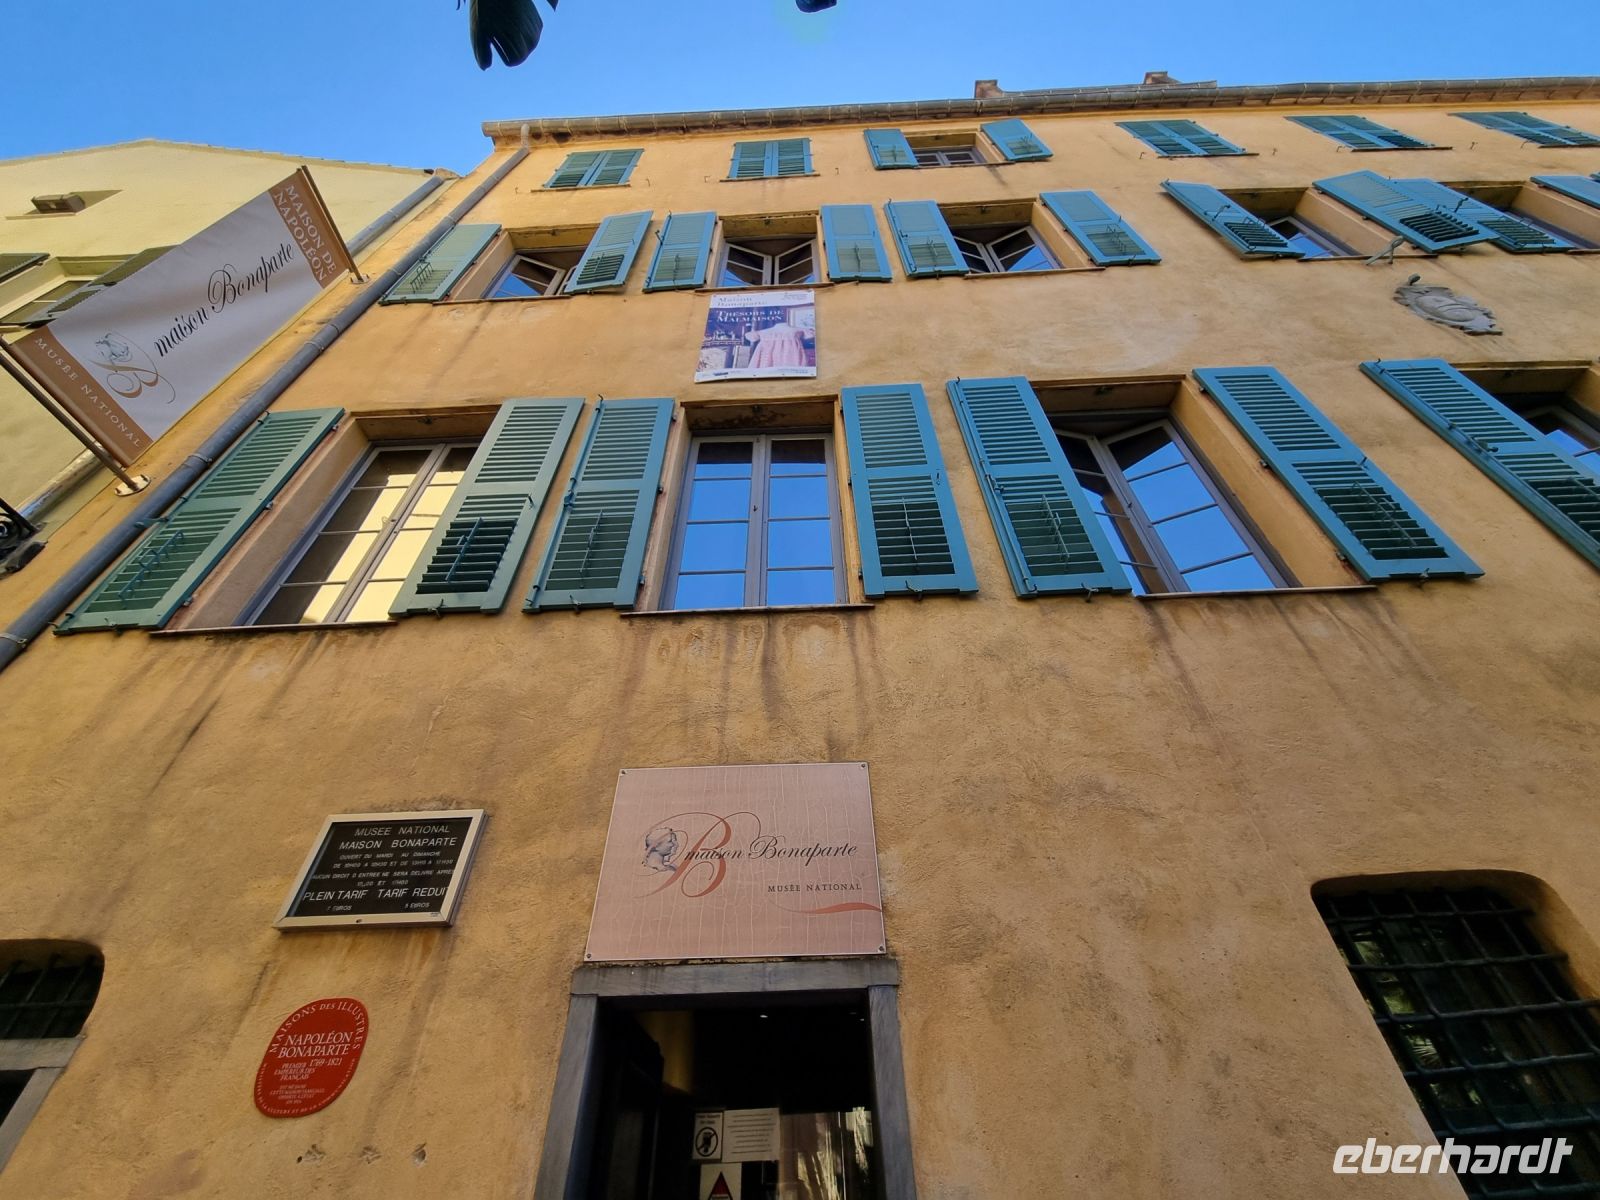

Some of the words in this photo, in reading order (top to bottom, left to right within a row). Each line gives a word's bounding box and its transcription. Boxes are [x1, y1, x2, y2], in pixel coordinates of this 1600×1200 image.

[273, 191, 329, 282] NAPOLÉON
[285, 184, 324, 253] MAISON
[321, 250, 338, 275] DE
[153, 305, 211, 359] maison
[207, 242, 295, 315] Bonaparte
[80, 383, 142, 448] NATIONAL
[354, 826, 392, 837] MUSEE
[398, 825, 450, 835] NATIONAL
[339, 840, 383, 850] MAISON
[391, 837, 458, 848] BONAPARTE
[685, 846, 744, 861] maison
[748, 835, 858, 867] Bonaparte
[303, 890, 334, 901] PLEIN
[337, 889, 369, 900] TARIF
[378, 888, 410, 898] TARIF
[768, 883, 801, 893] MUSÉE
[806, 882, 863, 892] NATIONAL
[270, 1004, 318, 1053] MAISONS
[336, 1001, 366, 1050] ILLUSTRES
[284, 1030, 354, 1047] NAPOLÉON
[277, 1043, 351, 1059] BONAPARTE
